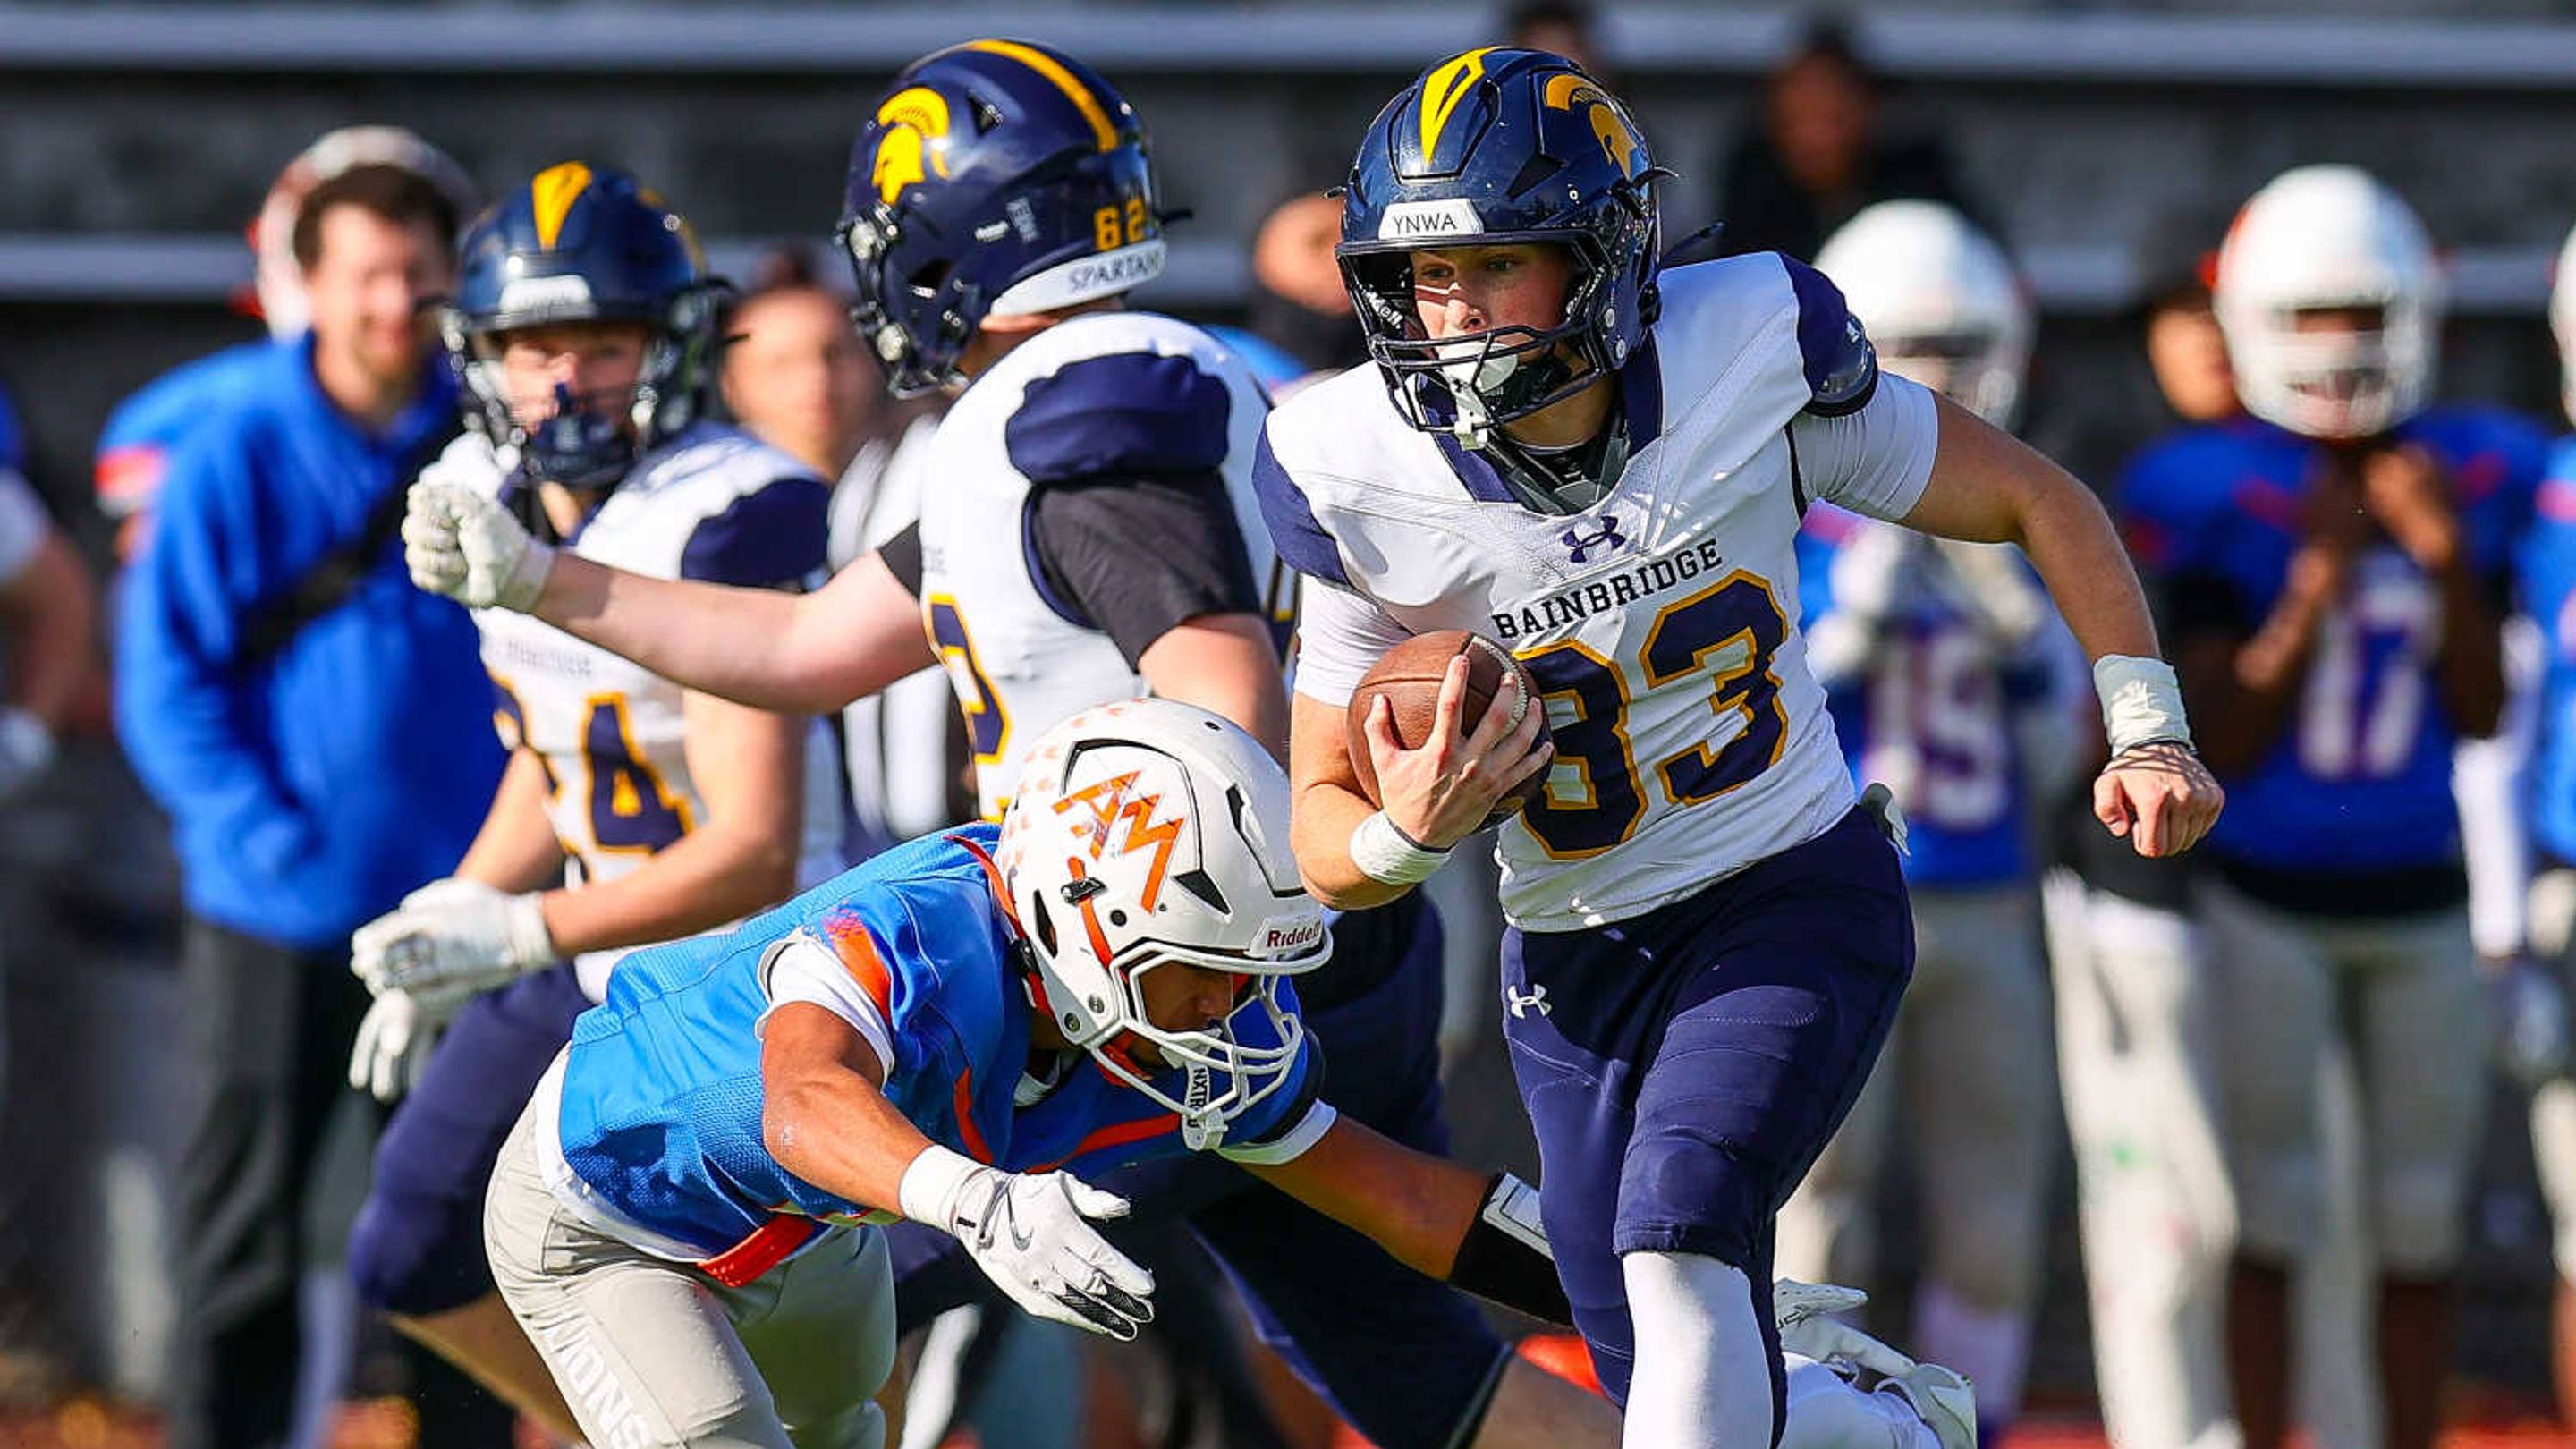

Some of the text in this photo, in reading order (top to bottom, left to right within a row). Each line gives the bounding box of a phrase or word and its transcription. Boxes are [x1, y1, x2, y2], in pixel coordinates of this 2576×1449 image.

[1093, 195, 1147, 251] 62
[1392, 213, 1458, 236] YNWA
[1491, 538, 1723, 639] BAINBRIDGE
[2299, 580, 2449, 780] 17
